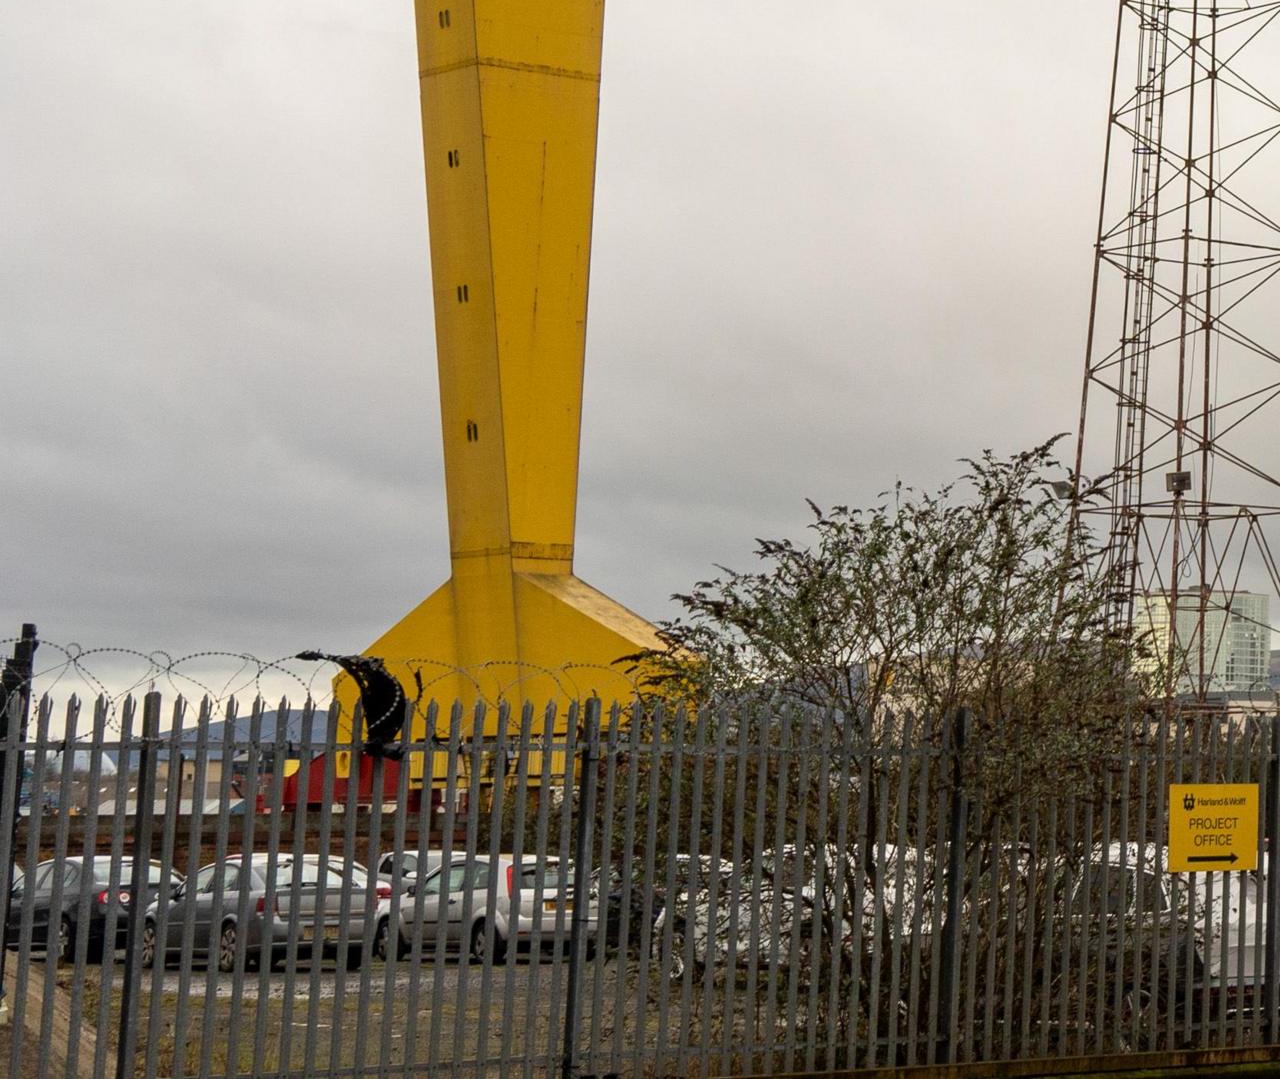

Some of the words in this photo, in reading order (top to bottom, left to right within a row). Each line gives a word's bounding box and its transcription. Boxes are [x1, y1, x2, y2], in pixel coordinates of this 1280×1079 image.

[1197, 798, 1224, 806] Harland
[1229, 797, 1246, 806] Wolff
[1189, 818, 1238, 829] PROJECT
[1194, 835, 1232, 846] OFFICE
